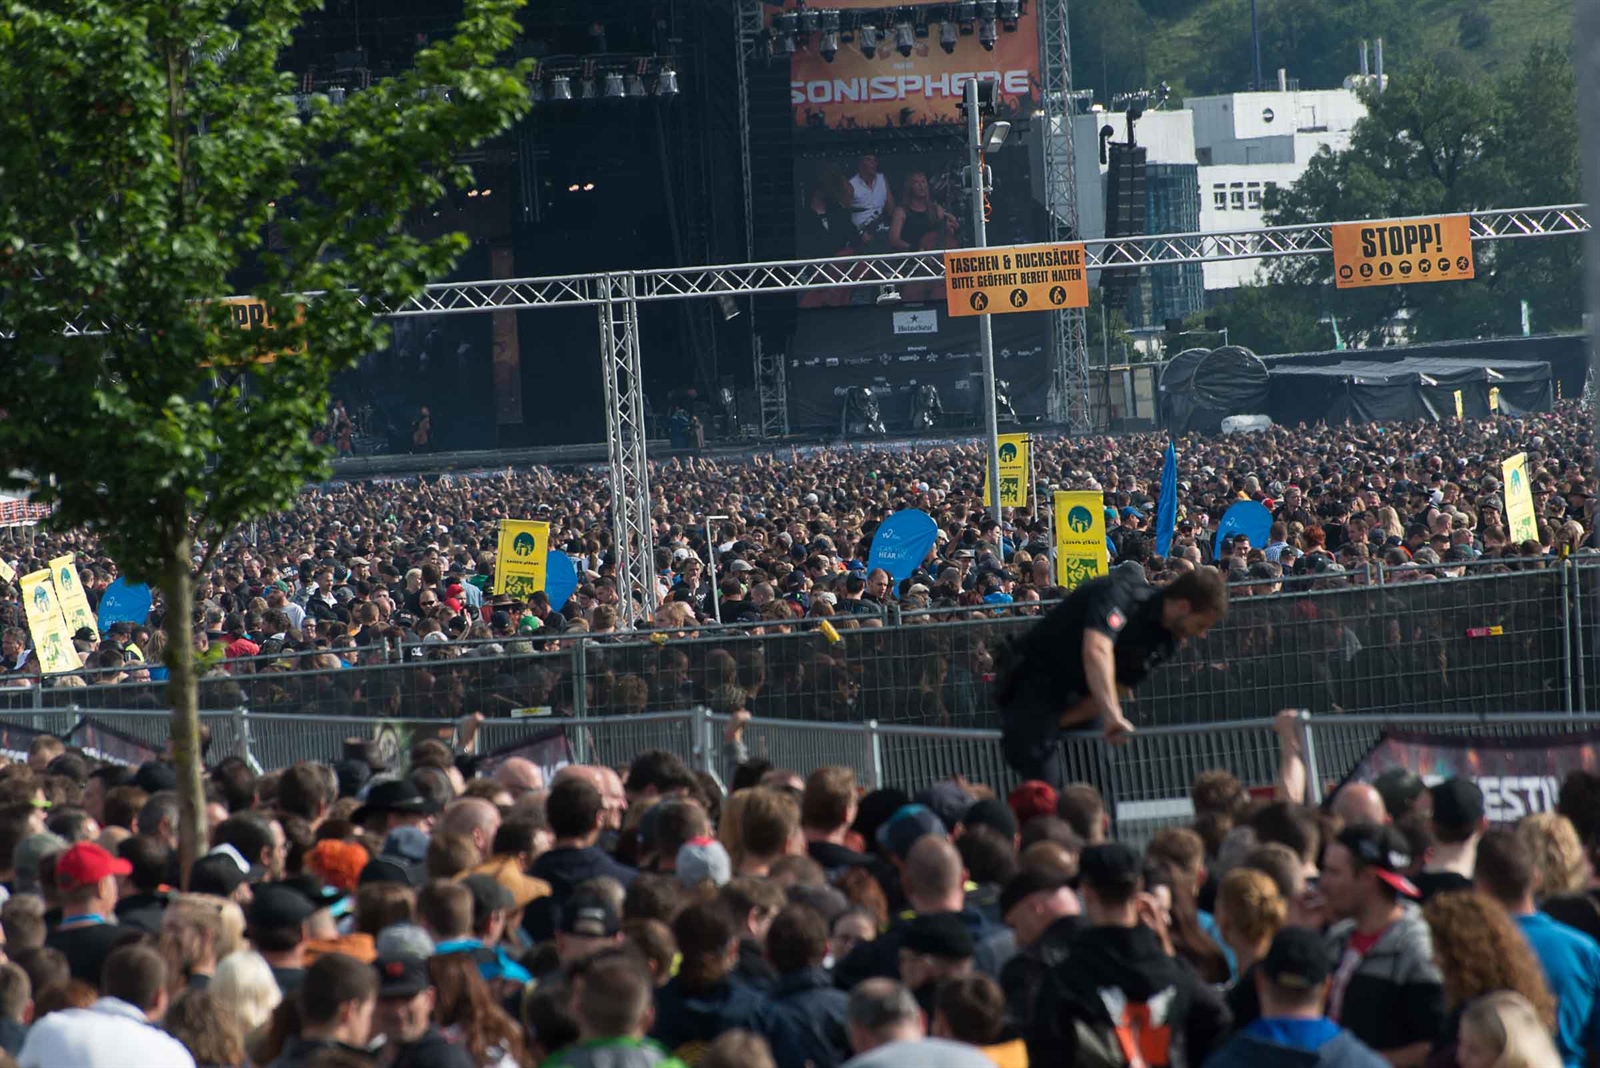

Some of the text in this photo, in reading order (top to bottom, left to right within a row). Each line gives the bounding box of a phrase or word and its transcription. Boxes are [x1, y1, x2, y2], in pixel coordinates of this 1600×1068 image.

[1361, 223, 1443, 258] STOPP!
[949, 248, 1081, 274] TASCHEN & RUCKSÄCKE
[951, 268, 1082, 289] BITTE GEÖFFNET BEREIT HALTEN
[879, 551, 896, 560] HEAR
